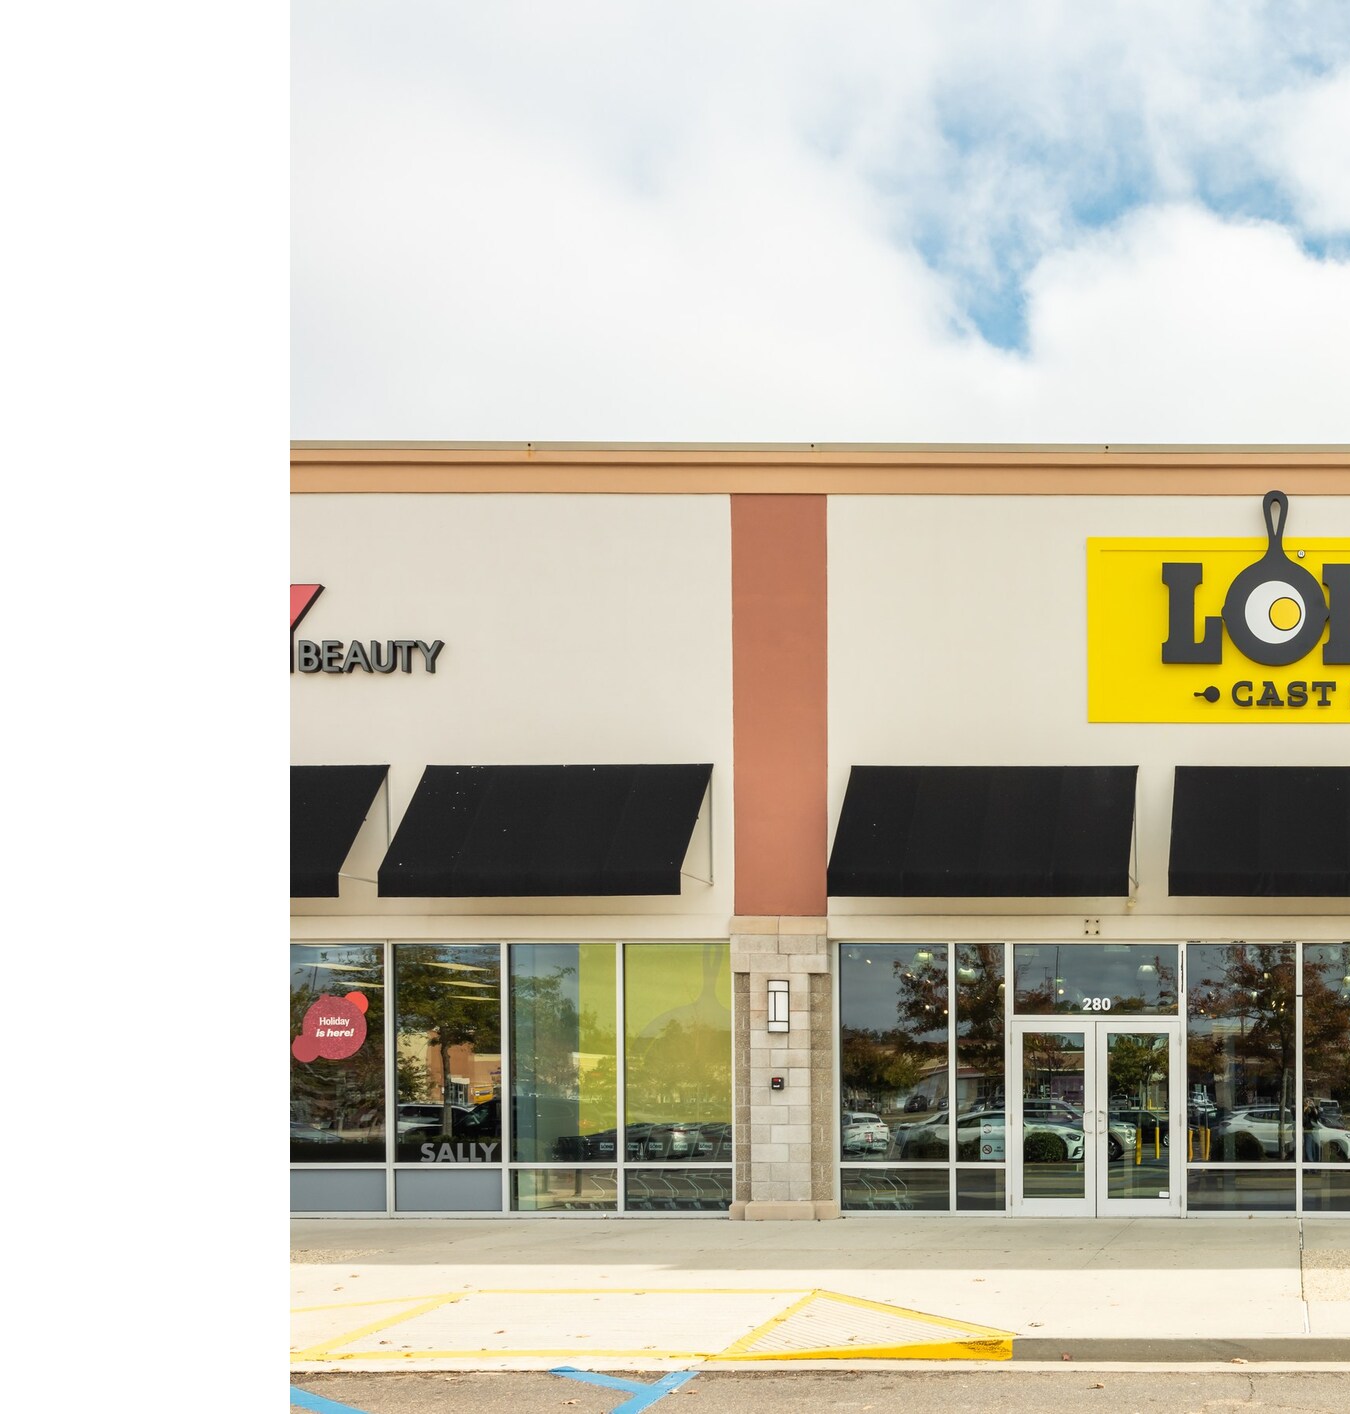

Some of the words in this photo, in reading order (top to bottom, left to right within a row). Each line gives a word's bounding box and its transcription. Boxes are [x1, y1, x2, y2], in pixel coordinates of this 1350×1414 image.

[298, 639, 446, 674] BEAUTY
[1231, 680, 1337, 708] CAST
[1082, 997, 1111, 1011] 280
[319, 1017, 350, 1027] Holiday
[316, 1028, 325, 1037] is
[326, 1028, 355, 1037] here!
[420, 1142, 499, 1162] SALLY
